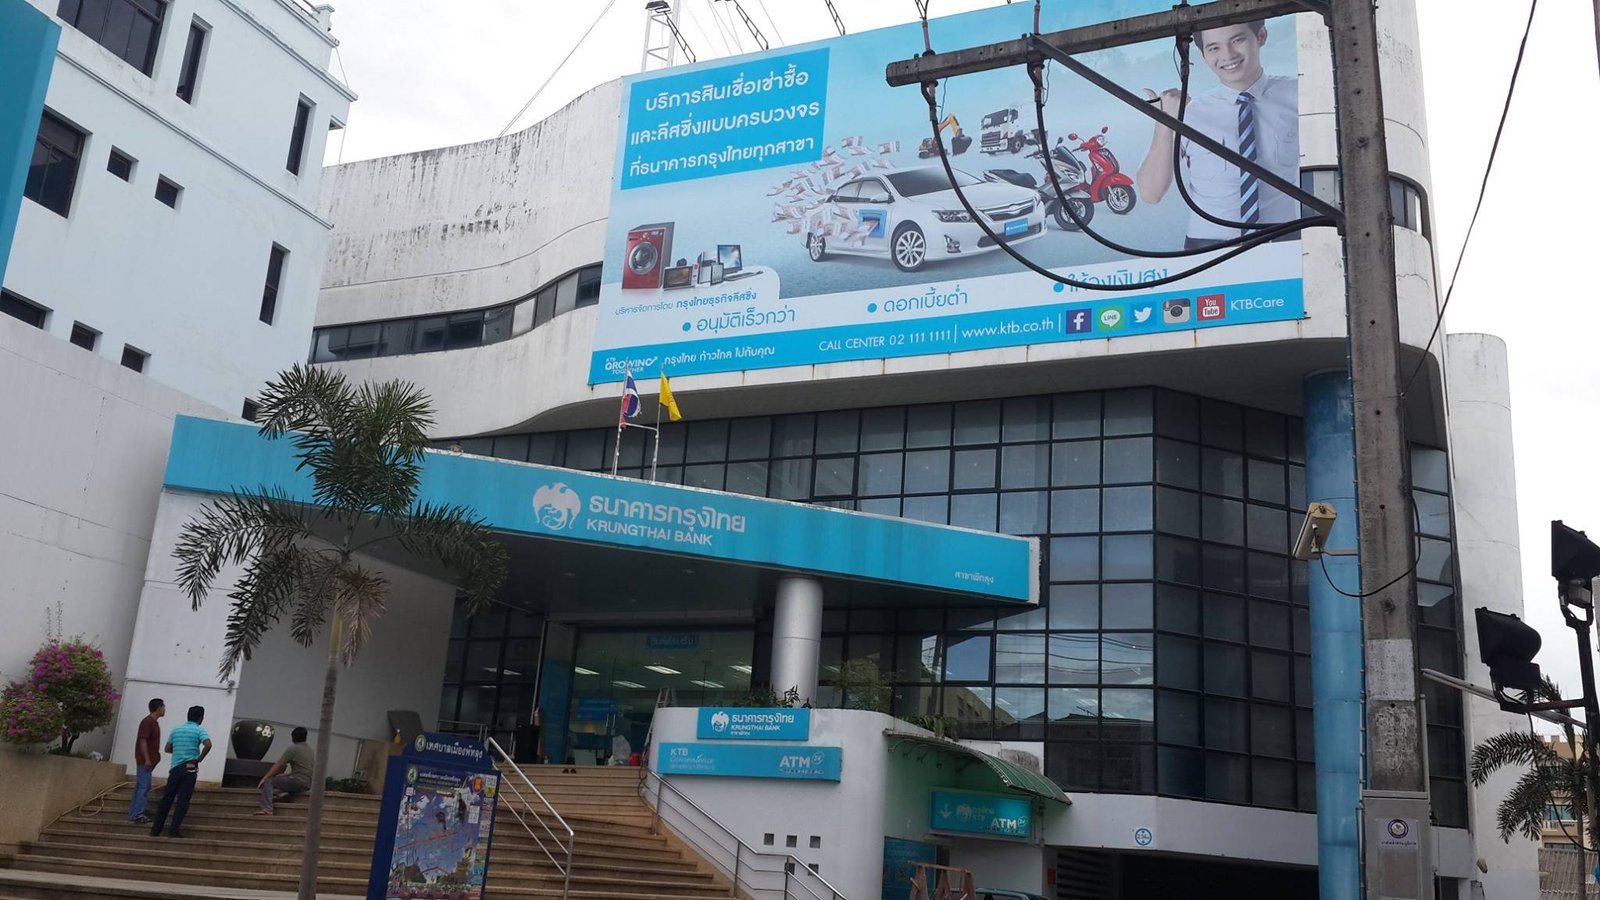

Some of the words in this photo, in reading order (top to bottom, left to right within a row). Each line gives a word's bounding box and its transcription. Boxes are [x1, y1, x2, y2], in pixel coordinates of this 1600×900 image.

[645, 64, 809, 111] บริการสินเชื่อเช่าซื้อ
[630, 101, 820, 145] และลีสซิ่งแบบครบวงจร
[629, 137, 815, 177] ที่ธนาคารกรุงไทยทุกสาขา
[615, 302, 673, 316] บริหารจัดการโดย
[675, 288, 757, 308] กรุงไทยธุรกิจลีสซิ่ง
[883, 284, 969, 313] ดอกเบี้ยต่ำ
[1205, 298, 1217, 307] You
[1231, 297, 1285, 311] KTBCare
[696, 305, 796, 334] อนุมัติเร็วกว่า
[1103, 314, 1118, 322] LINE
[1204, 307, 1219, 316] Tube
[961, 316, 1054, 338] www.ktb.co.th
[818, 339, 842, 353] CALL
[845, 336, 885, 350] CENTER
[889, 334, 905, 346] 02
[909, 332, 926, 344] 111
[929, 330, 951, 342] 1111
[605, 356, 658, 370] GROWING
[664, 352, 697, 367] กรุงไทย
[699, 349, 732, 362] ก้าวไกล
[735, 345, 776, 361] ไปกับคุณ
[588, 495, 746, 533] ธนาคารกรุงไทย
[586, 518, 671, 541] KRUNGTHAI
[674, 530, 714, 546] BANK
[731, 712, 795, 725] ธนาคารกรุงไทย
[671, 748, 689, 756] KTB
[779, 755, 811, 768] ATM
[991, 817, 1017, 829] ATM
